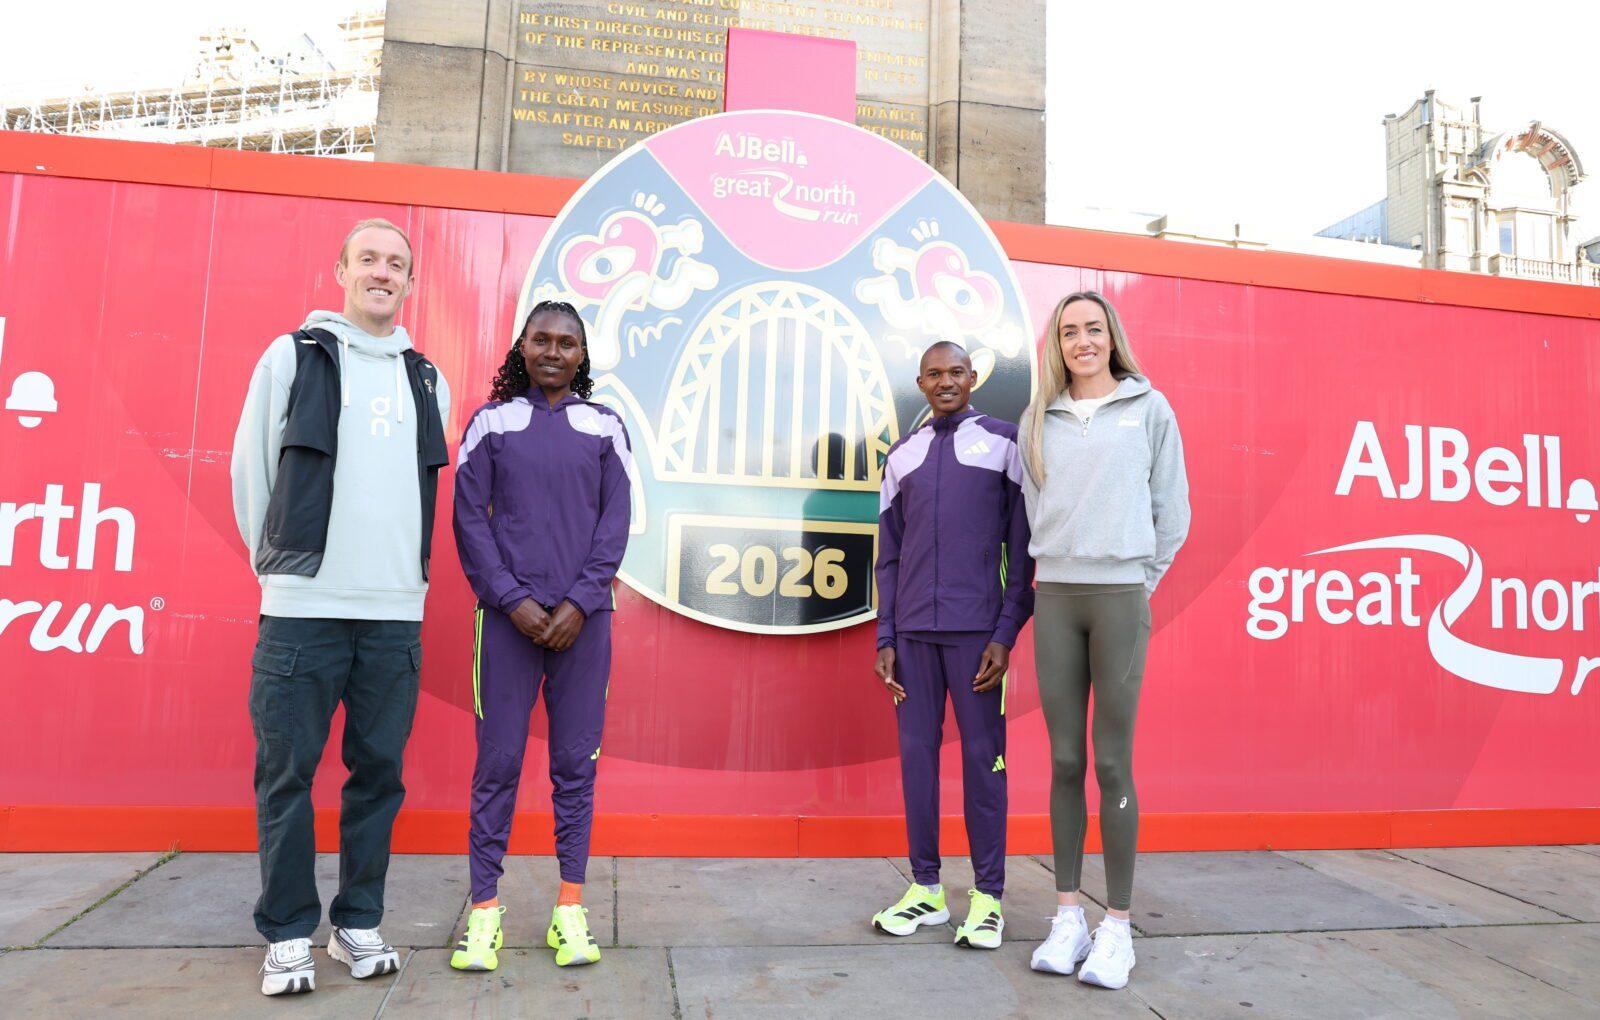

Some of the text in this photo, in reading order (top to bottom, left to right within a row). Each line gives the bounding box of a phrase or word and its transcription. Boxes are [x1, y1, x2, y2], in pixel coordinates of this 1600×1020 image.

[607, 2, 649, 18] CIVIL
[656, 8, 688, 22] AND
[520, 12, 540, 25] HE
[544, 14, 592, 30] FIRST
[595, 20, 673, 39] DIRECTED
[677, 29, 701, 42] HIS
[705, 31, 728, 45] EF
[525, 31, 547, 44] OF
[554, 34, 586, 49] THE
[626, 61, 660, 76] AND
[665, 65, 701, 80] WAS
[524, 70, 547, 84] BY
[555, 74, 613, 90] WHOSE
[684, 86, 717, 101] AND
[520, 88, 552, 104] THE
[557, 93, 610, 109] GREAT
[616, 98, 694, 117] MEASURE
[552, 111, 604, 128] AFTER
[609, 117, 631, 130] AN
[562, 132, 628, 149] SAFELY
[713, 176, 857, 207] great north
[823, 210, 860, 226] run
[706, 543, 849, 600] 2026
[1246, 557, 1421, 640] great
[0, 598, 145, 655] run
